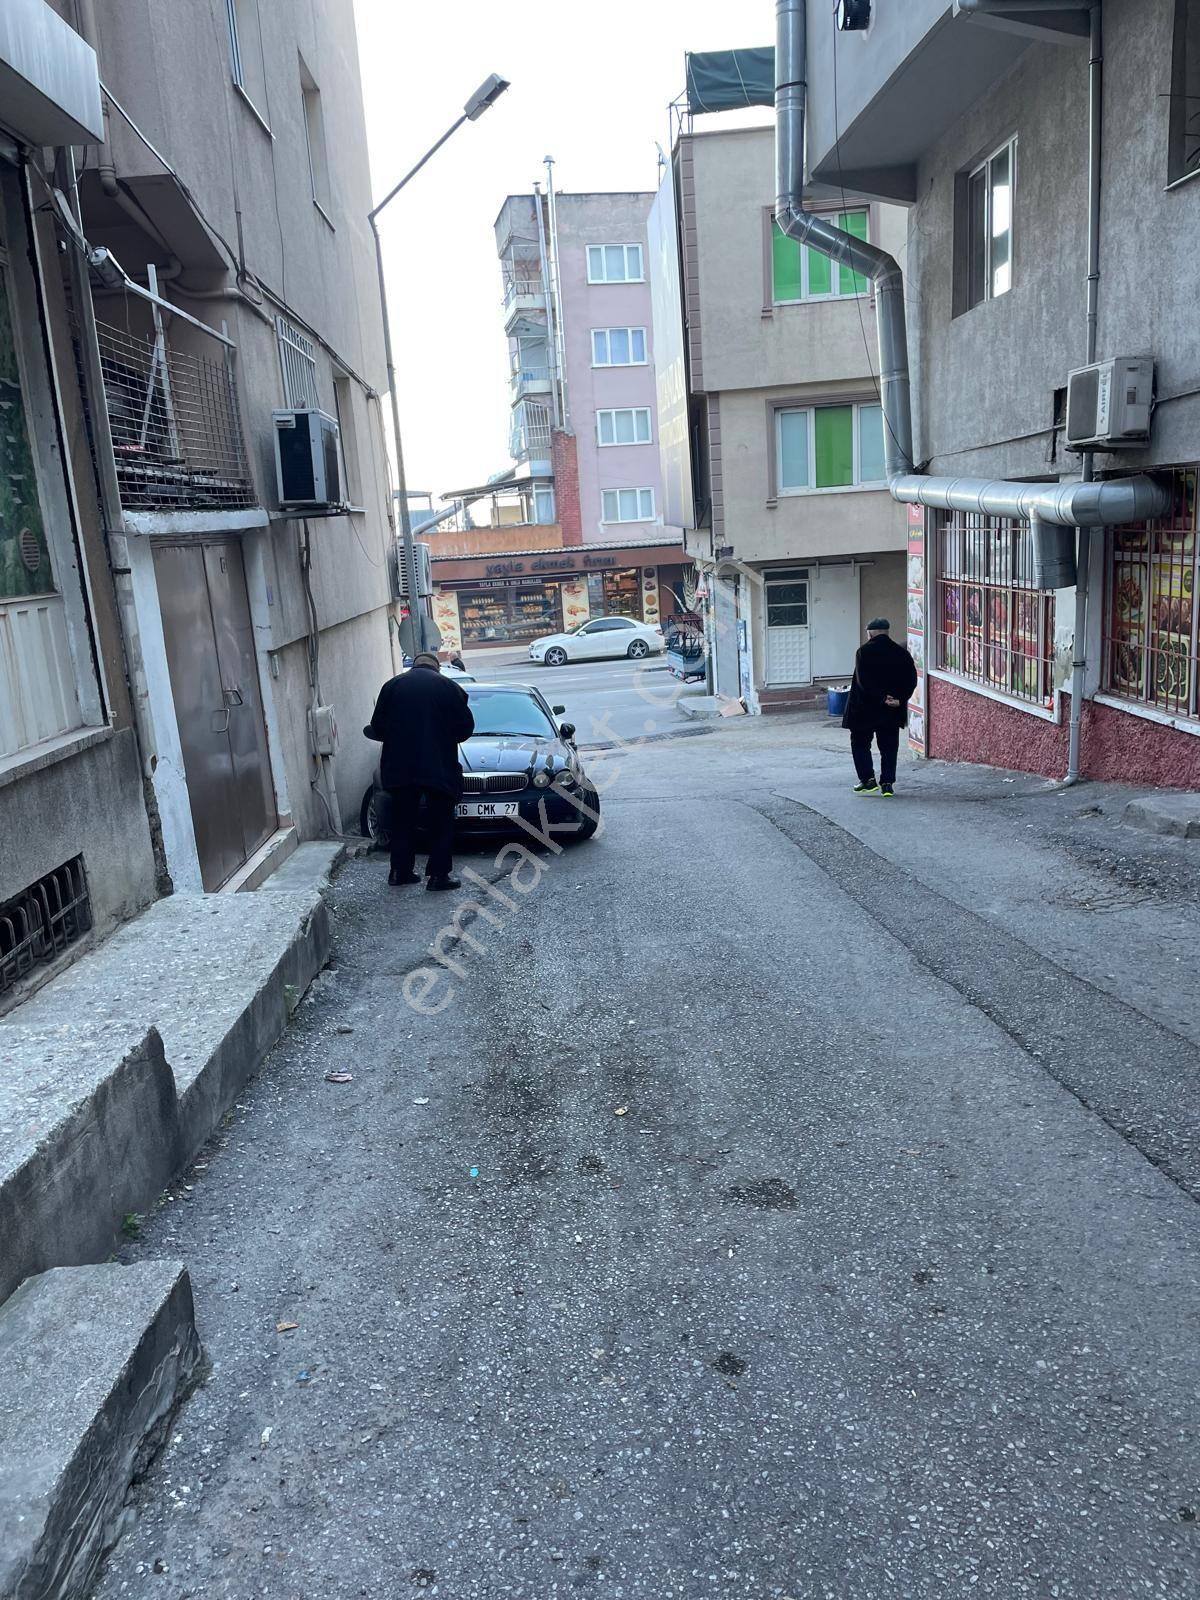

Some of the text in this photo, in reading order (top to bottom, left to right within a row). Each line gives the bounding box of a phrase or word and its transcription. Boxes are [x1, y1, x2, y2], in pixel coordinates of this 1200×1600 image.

[486, 560, 523, 577] yayla
[531, 557, 575, 571] ekmek
[458, 803, 517, 815] 16 CMK 27
